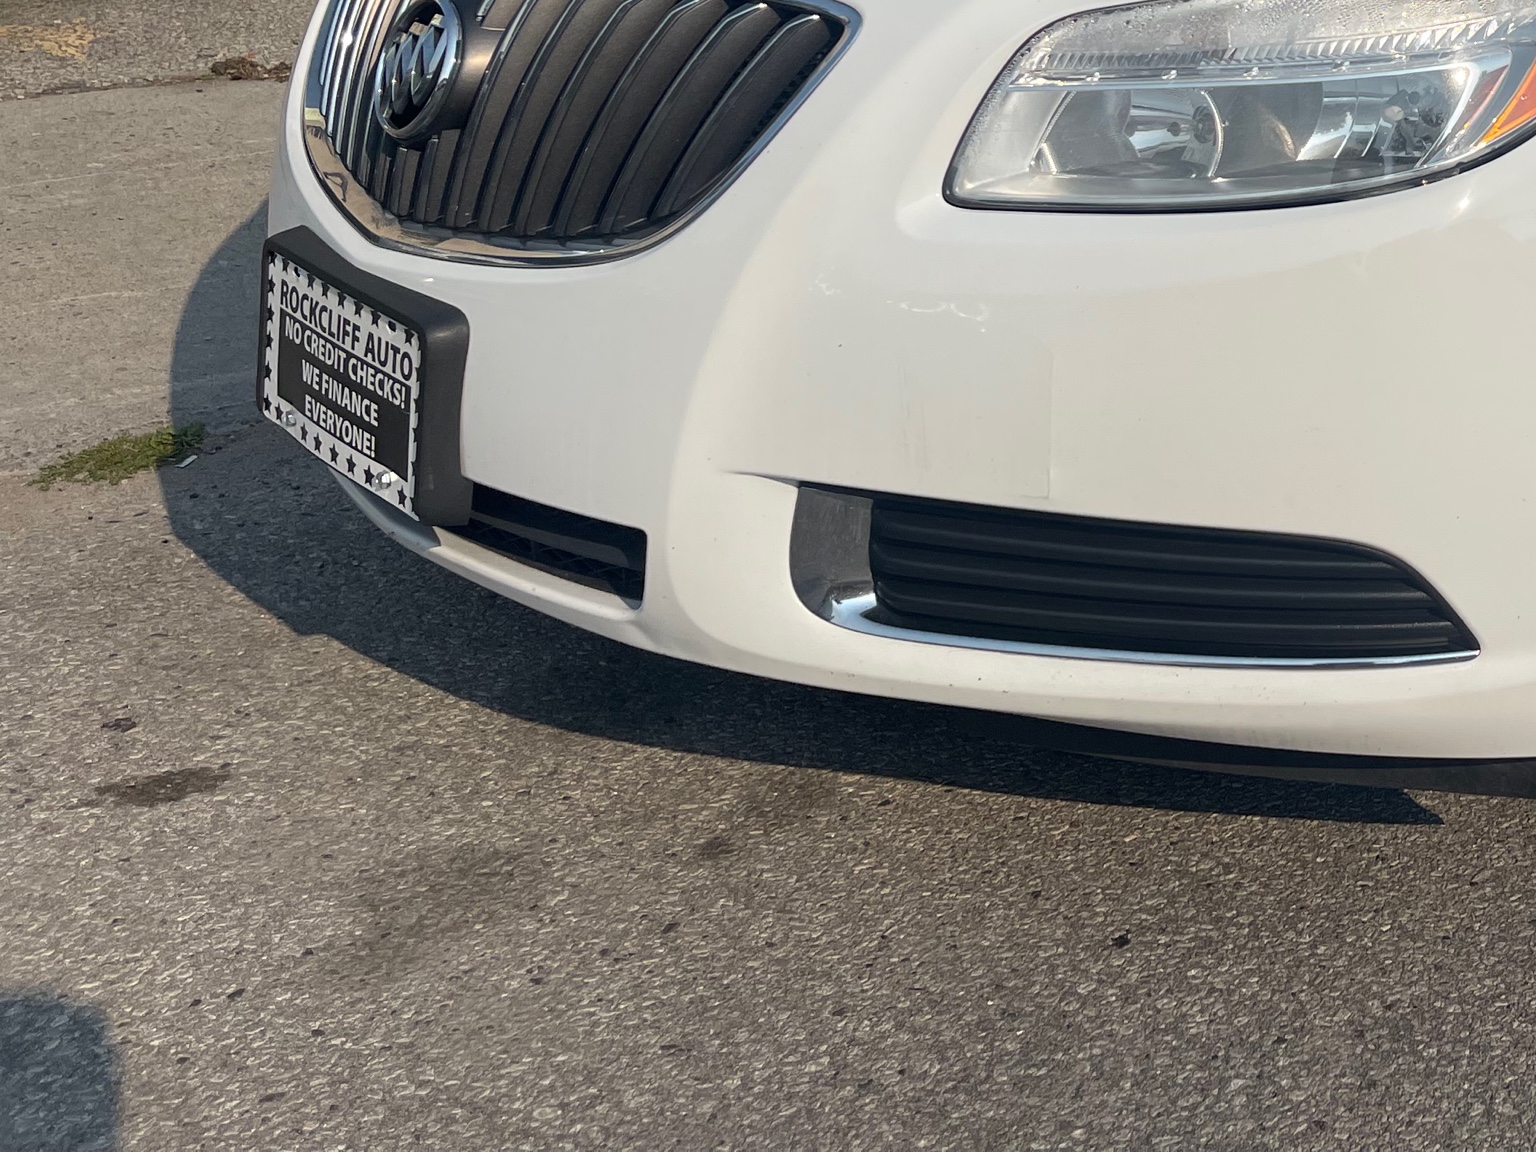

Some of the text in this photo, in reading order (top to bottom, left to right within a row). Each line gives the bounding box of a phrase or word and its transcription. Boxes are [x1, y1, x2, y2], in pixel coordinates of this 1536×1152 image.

[279, 278, 414, 382] ROCKCLIFF AUTO
[284, 315, 407, 410] NO CREDIT CHECKS!
[301, 359, 379, 428] WE FINANCE
[304, 393, 377, 459] EVERYONE!
